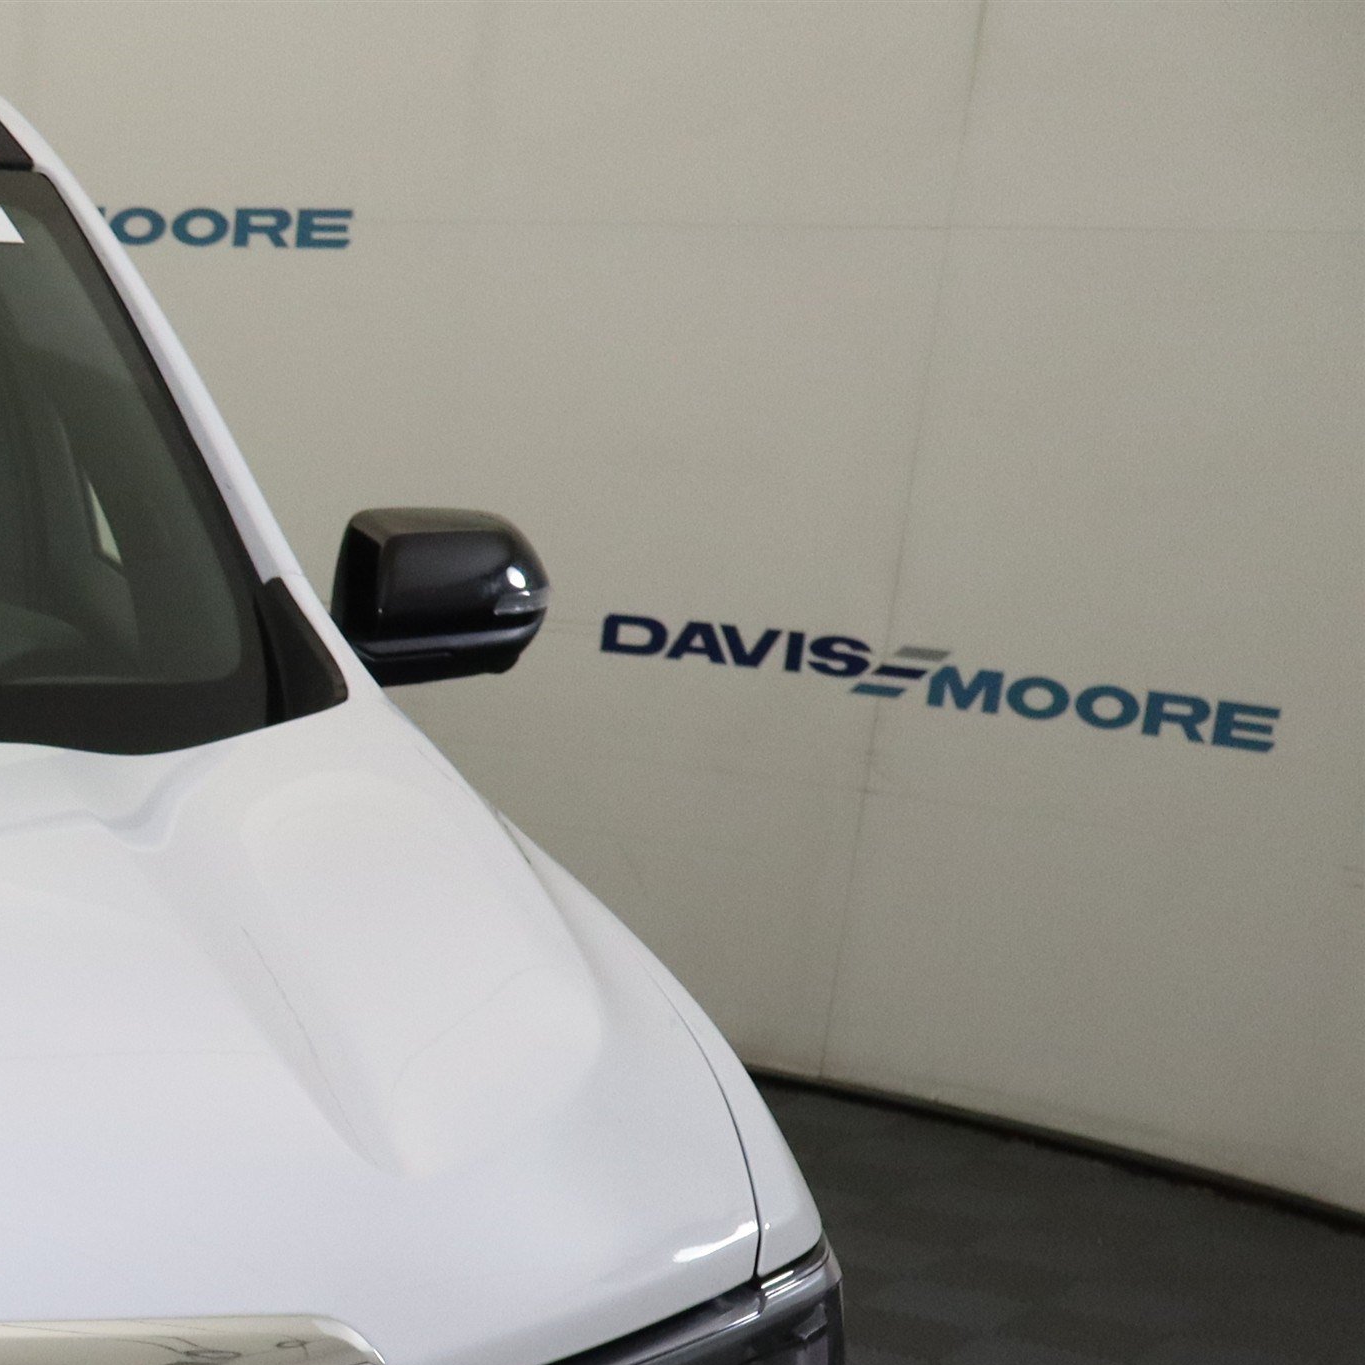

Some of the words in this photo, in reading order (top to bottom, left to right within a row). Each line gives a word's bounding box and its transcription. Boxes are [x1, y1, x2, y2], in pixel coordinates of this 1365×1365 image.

[96, 206, 354, 249] OORE
[600, 613, 873, 678] DAVIS
[925, 664, 1280, 752] MOORE
